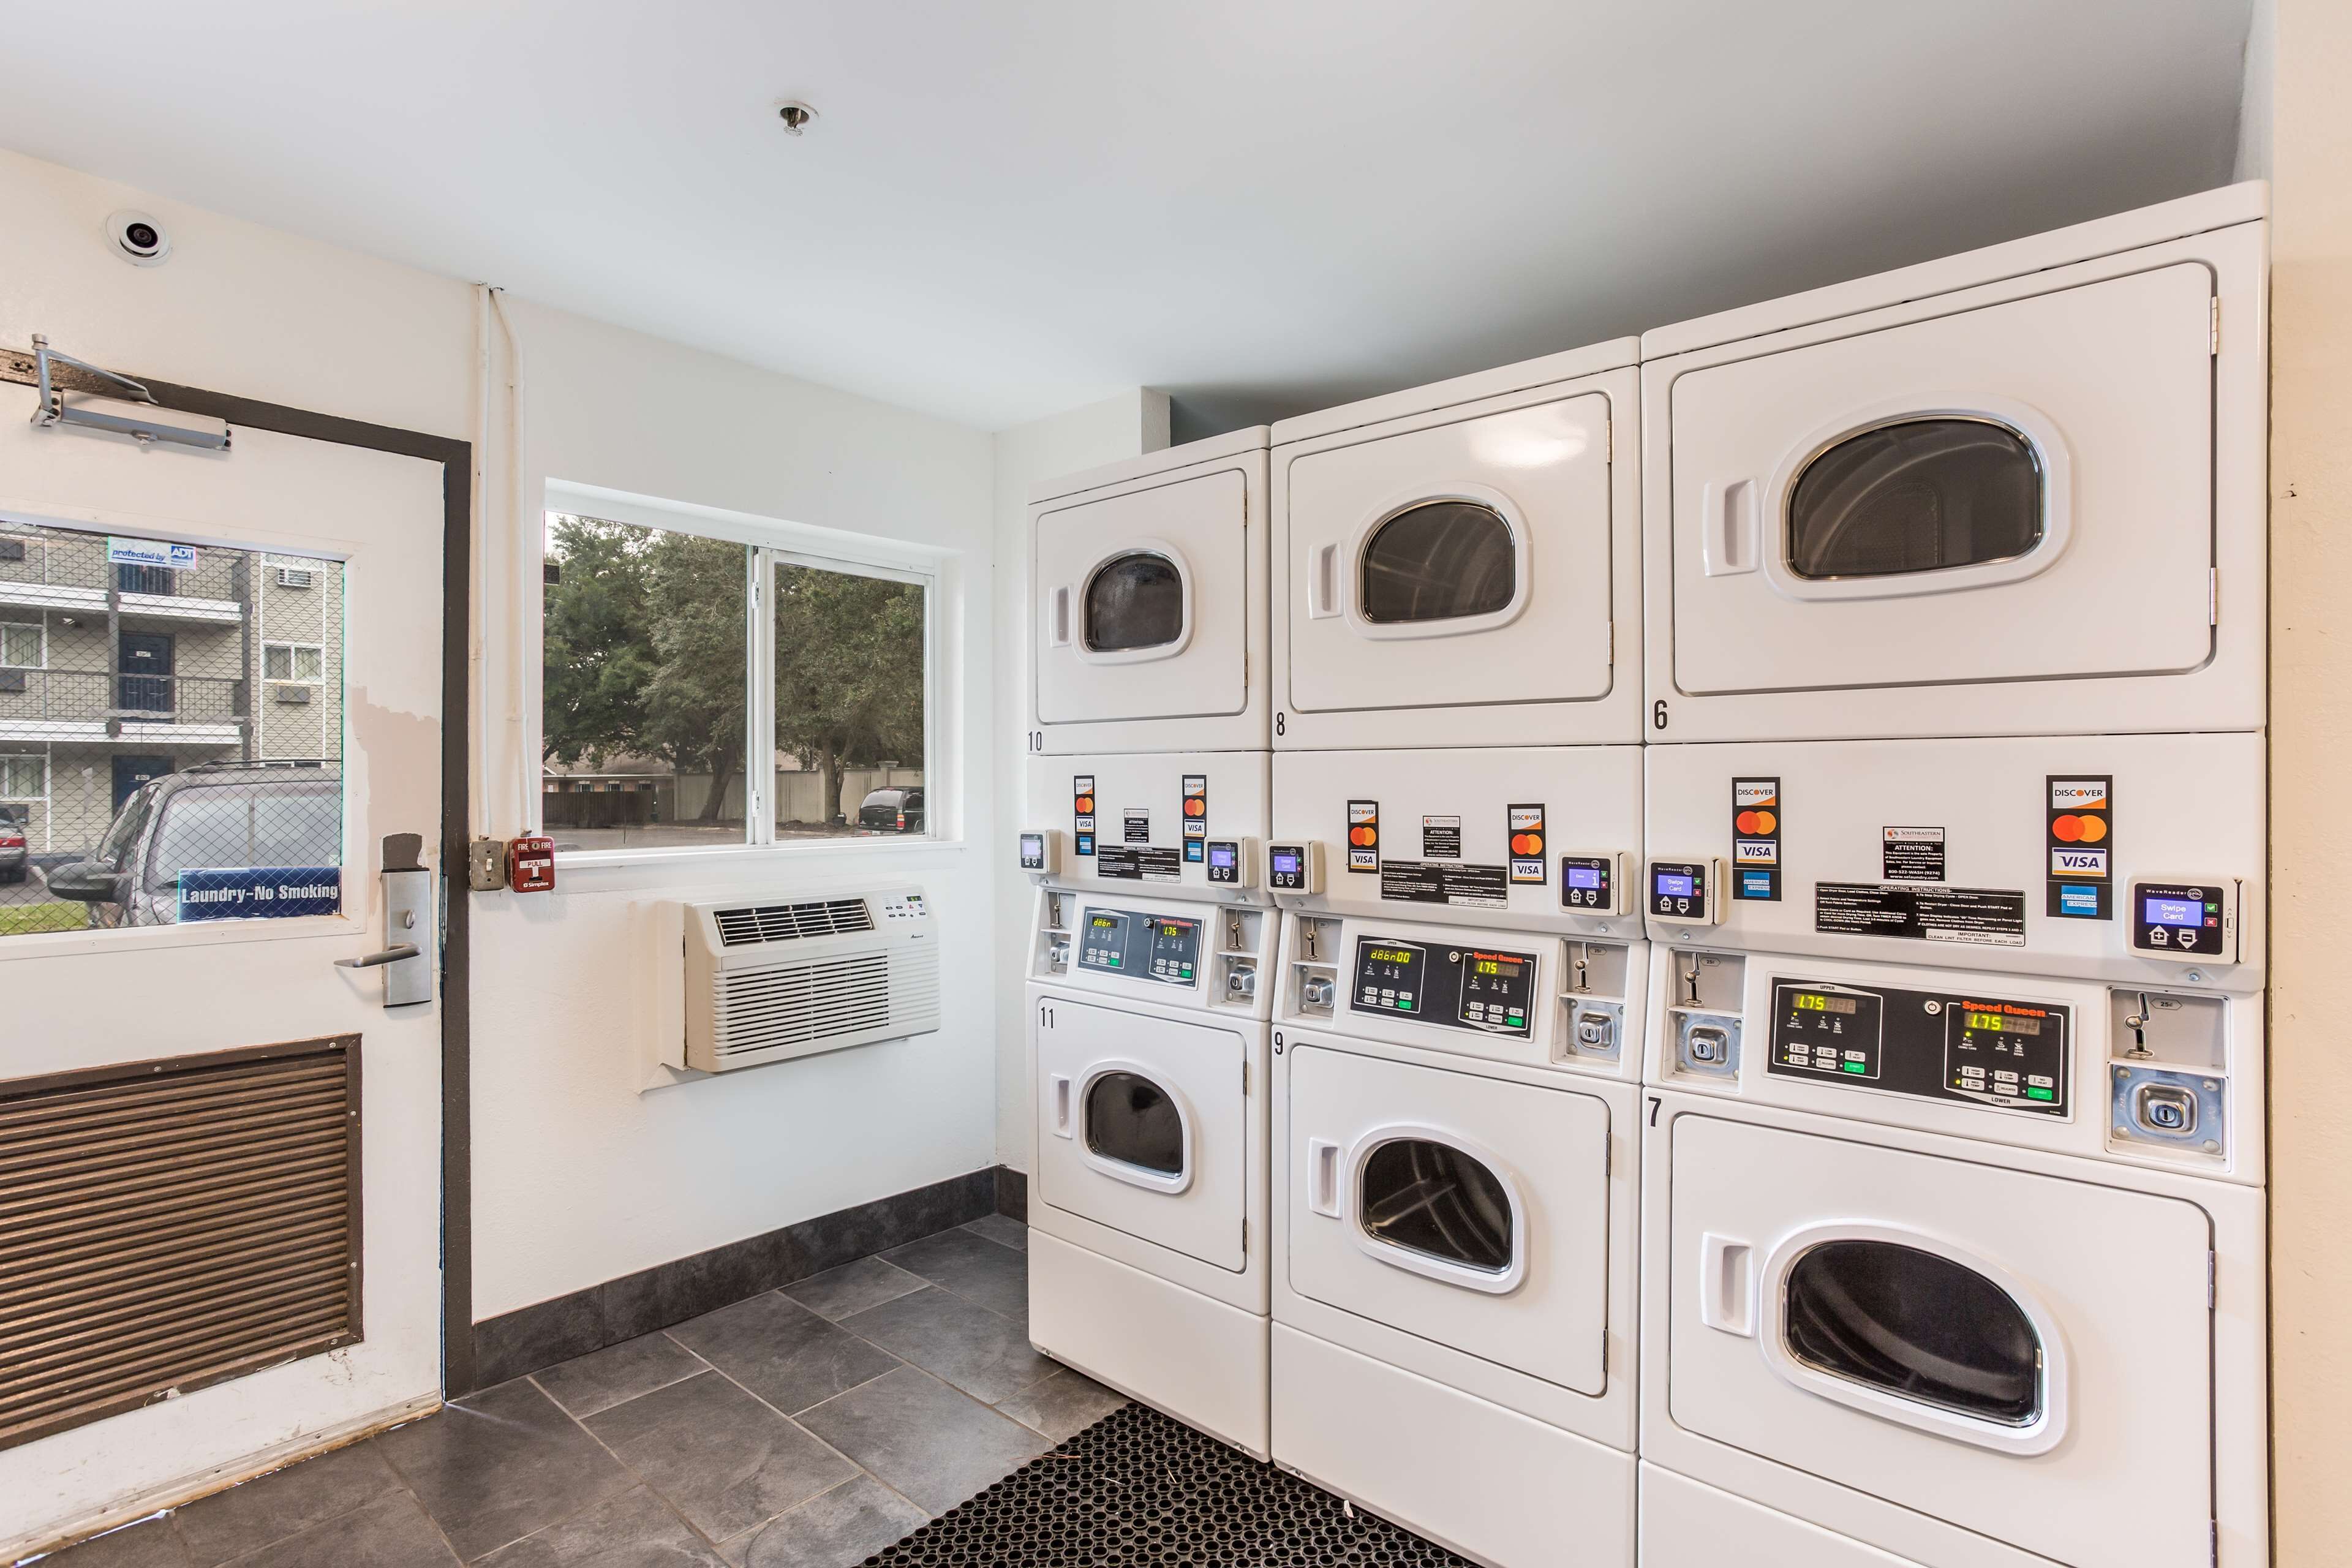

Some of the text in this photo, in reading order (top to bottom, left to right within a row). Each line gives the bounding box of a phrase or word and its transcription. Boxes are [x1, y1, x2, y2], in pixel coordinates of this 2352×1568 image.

[112, 549, 154, 560] protected
[172, 548, 192, 558] ADT
[1654, 699, 1667, 729] 6
[1276, 712, 1285, 736] 8
[1028, 731, 1042, 751] 10
[1741, 846, 1771, 856] VISA
[1354, 855, 1373, 864] VISA
[2059, 856, 2099, 868] VISA
[1517, 865, 1539, 874] VISA
[279, 884, 338, 899] Smoking
[1473, 952, 1523, 963] Speed Queen
[1478, 962, 1498, 974] 1.75
[1799, 995, 1824, 1010] 1.75
[1962, 1001, 2046, 1017] Speed Queen
[1041, 1006, 1053, 1028] 11
[1972, 1014, 2001, 1030] 1.75
[1275, 1031, 1283, 1055] 9
[1648, 1096, 1661, 1127] 7
